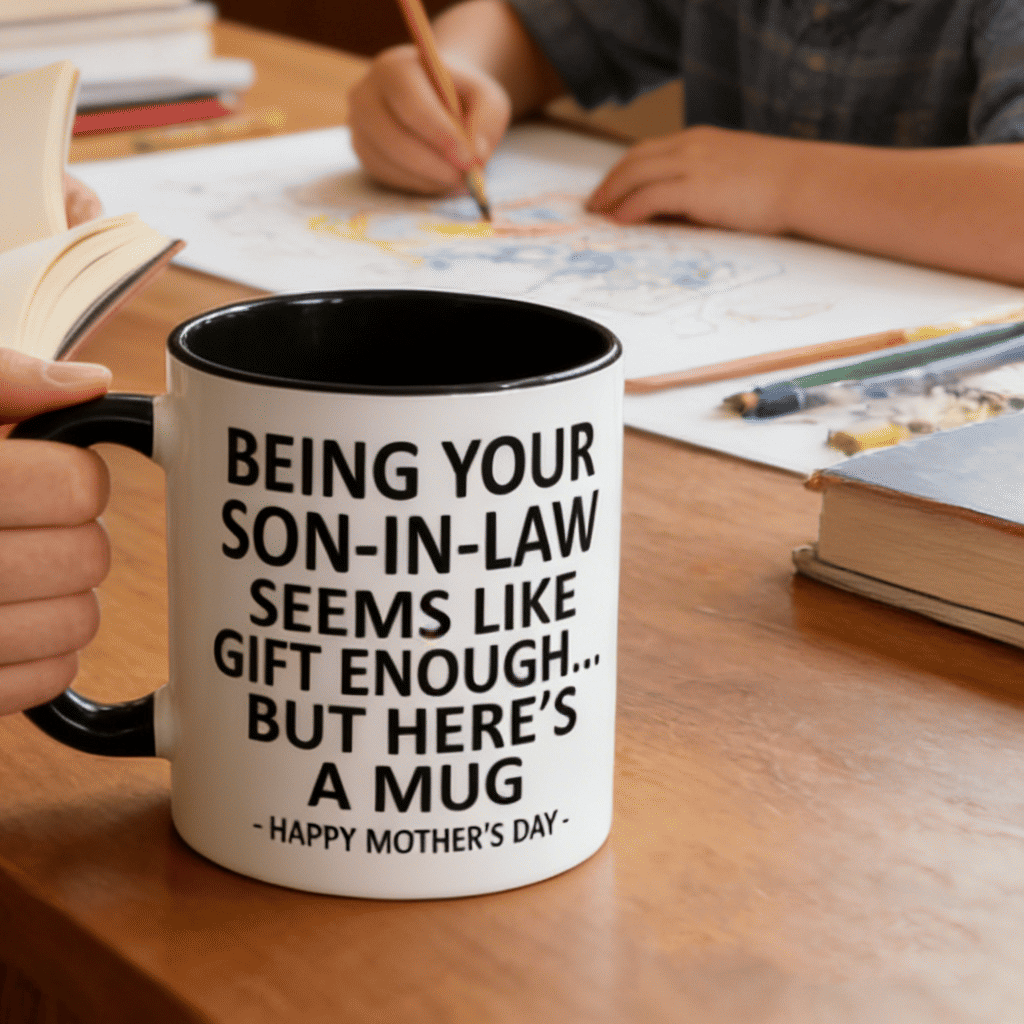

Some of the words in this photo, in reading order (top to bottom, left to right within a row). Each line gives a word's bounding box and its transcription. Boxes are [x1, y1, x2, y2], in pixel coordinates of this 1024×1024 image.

[226, 424, 419, 502] BEING
[442, 422, 595, 499] YOUR
[221, 490, 599, 576] SON-IN-LAW
[249, 578, 451, 640] SEEMS
[475, 571, 577, 635] LIKE
[213, 628, 323, 692] GIFT
[341, 630, 600, 697] ENOUGH...
[247, 692, 367, 754] BUT
[307, 762, 352, 811] A
[375, 757, 523, 814] MUG
[269, 815, 357, 852] HAPPY
[513, 809, 558, 845] DAY
